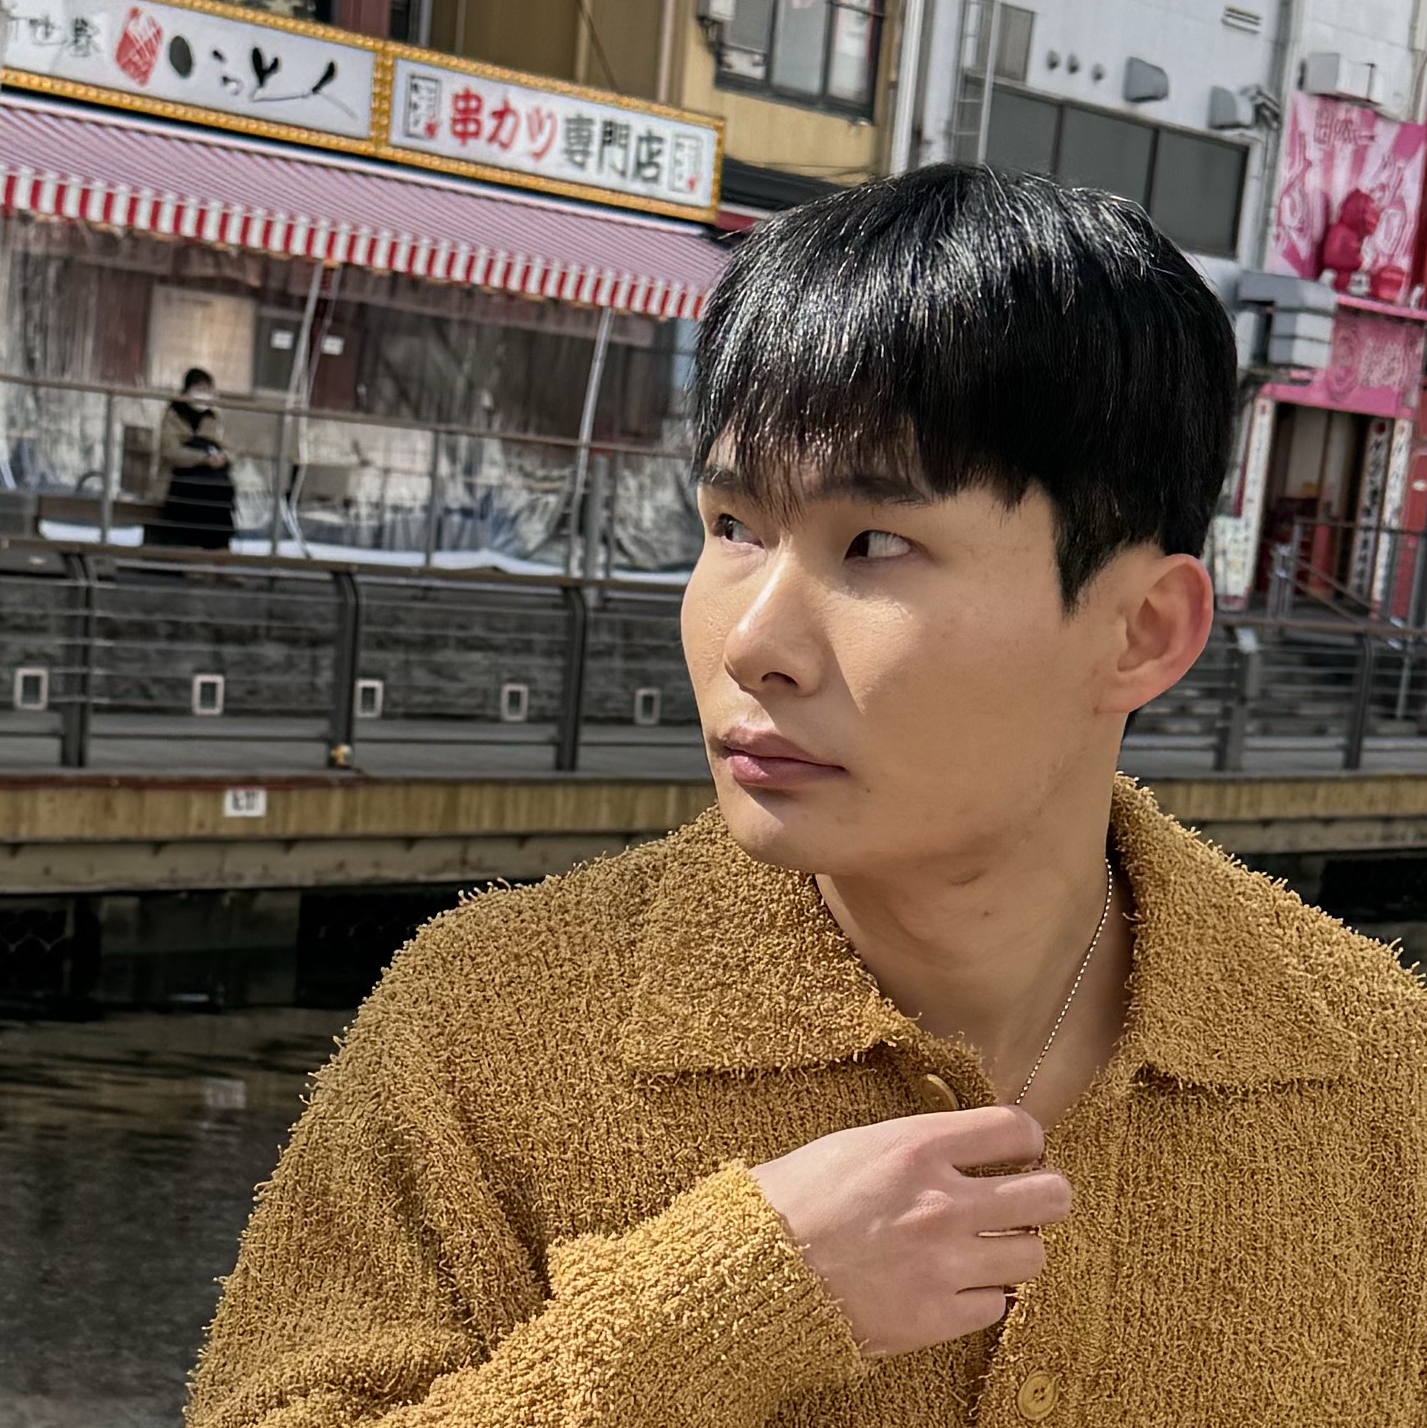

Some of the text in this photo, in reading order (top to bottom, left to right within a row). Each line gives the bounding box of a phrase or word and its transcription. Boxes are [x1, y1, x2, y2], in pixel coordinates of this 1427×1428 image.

[449, 88, 663, 183] 串カツ専門店
